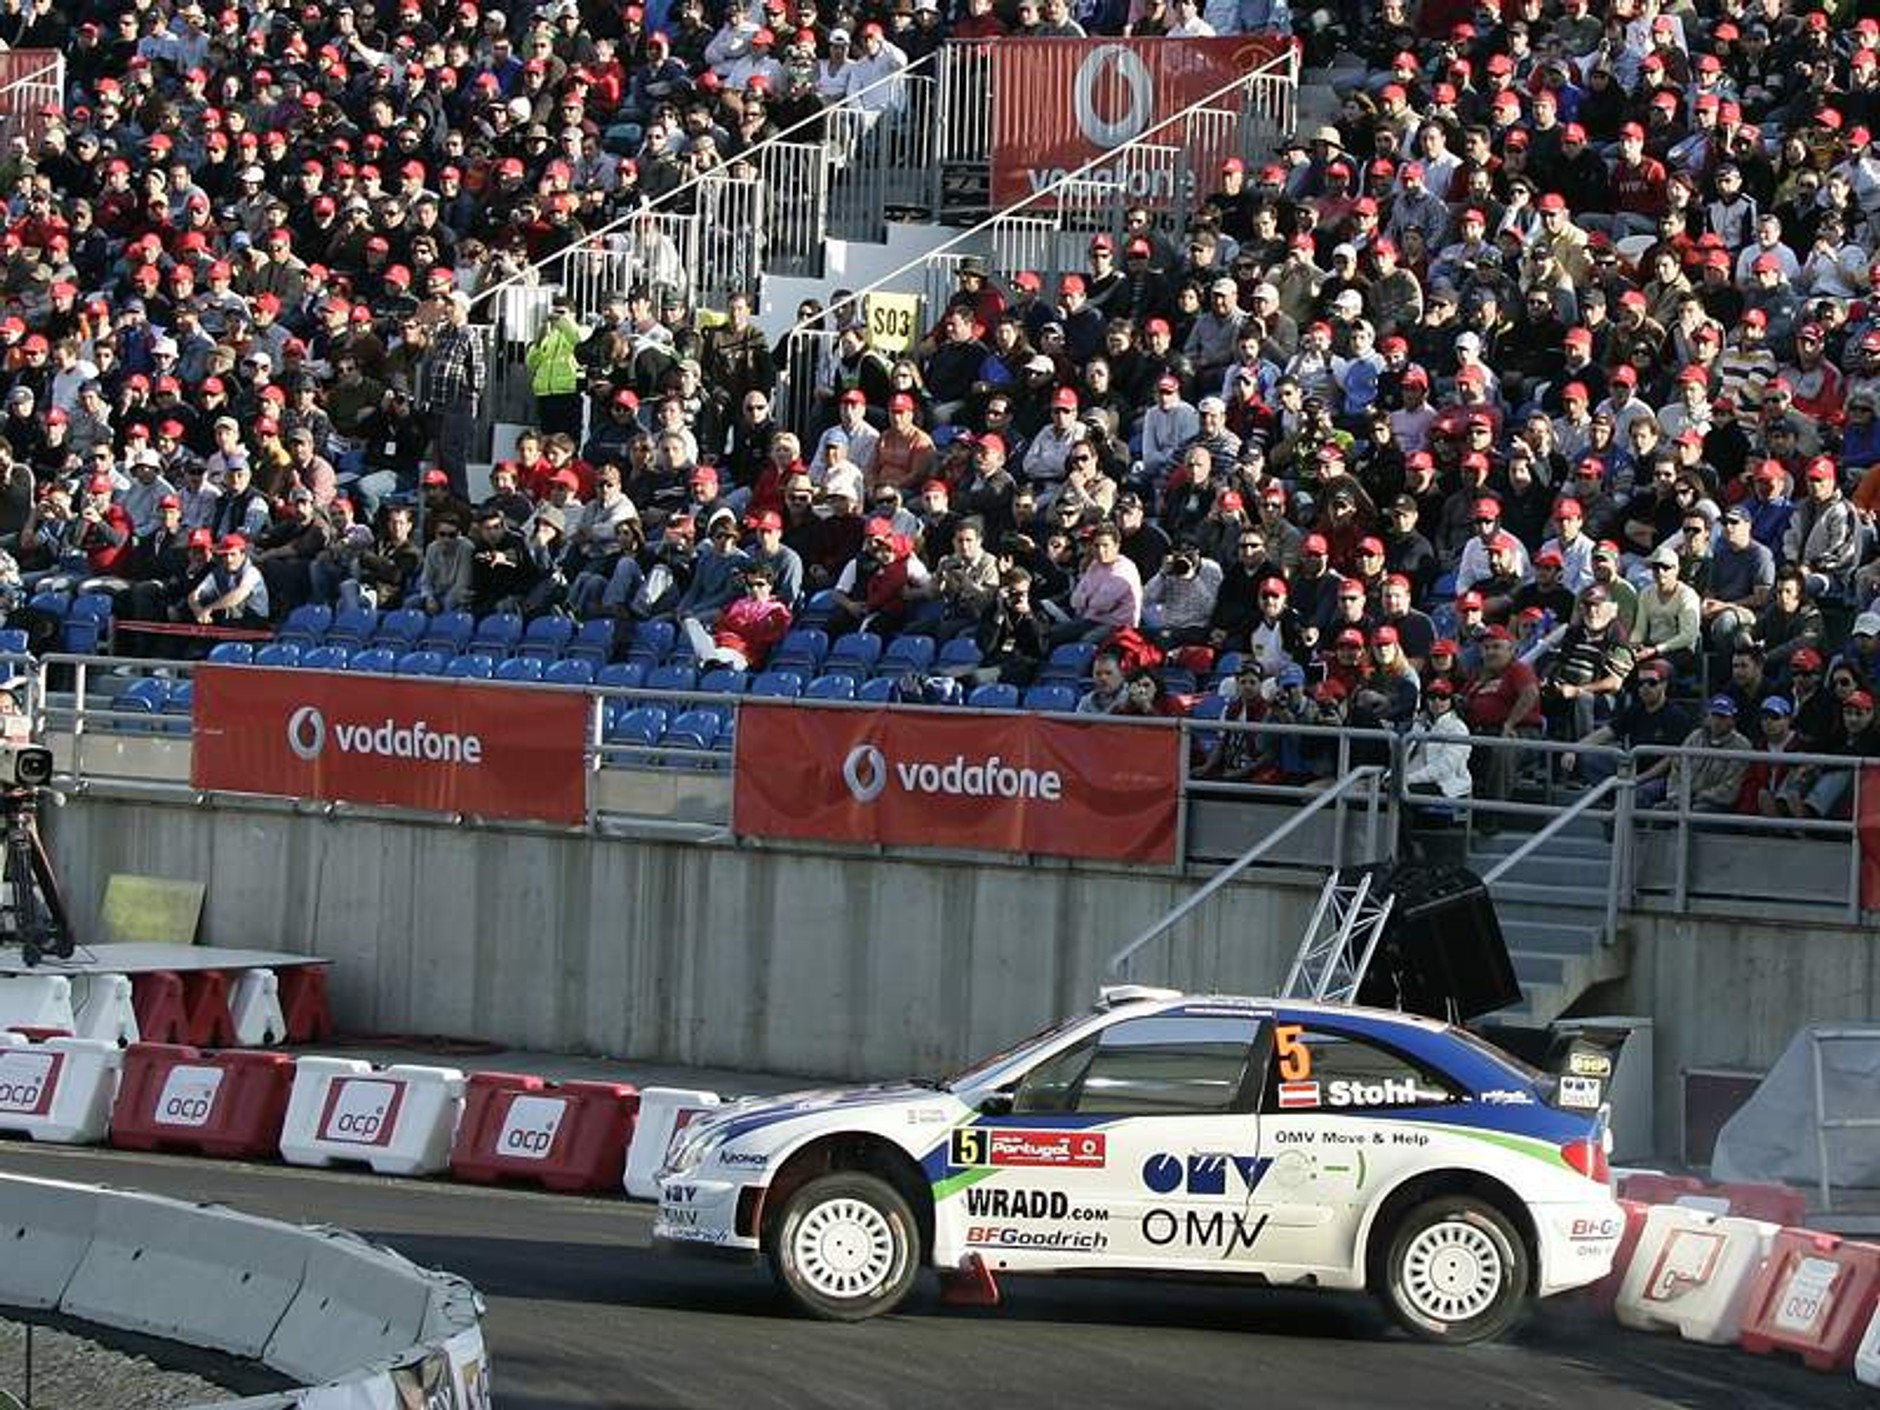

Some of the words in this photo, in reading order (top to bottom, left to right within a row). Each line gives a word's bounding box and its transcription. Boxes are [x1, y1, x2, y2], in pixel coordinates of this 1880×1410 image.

[873, 306, 910, 338] S03
[334, 719, 482, 764] vodafone
[898, 756, 1062, 801] vodafone
[1276, 1025, 1311, 1081] 5
[1328, 1078, 1416, 1107] Stohl
[961, 1131, 979, 1163] 5
[1275, 1130, 1315, 1144] OMV
[1322, 1131, 1366, 1145] Move
[1372, 1131, 1385, 1145] &
[1393, 1132, 1430, 1147] Help
[967, 1226, 1109, 1249] BFGoodrich
[1142, 1208, 1270, 1248] OMV
